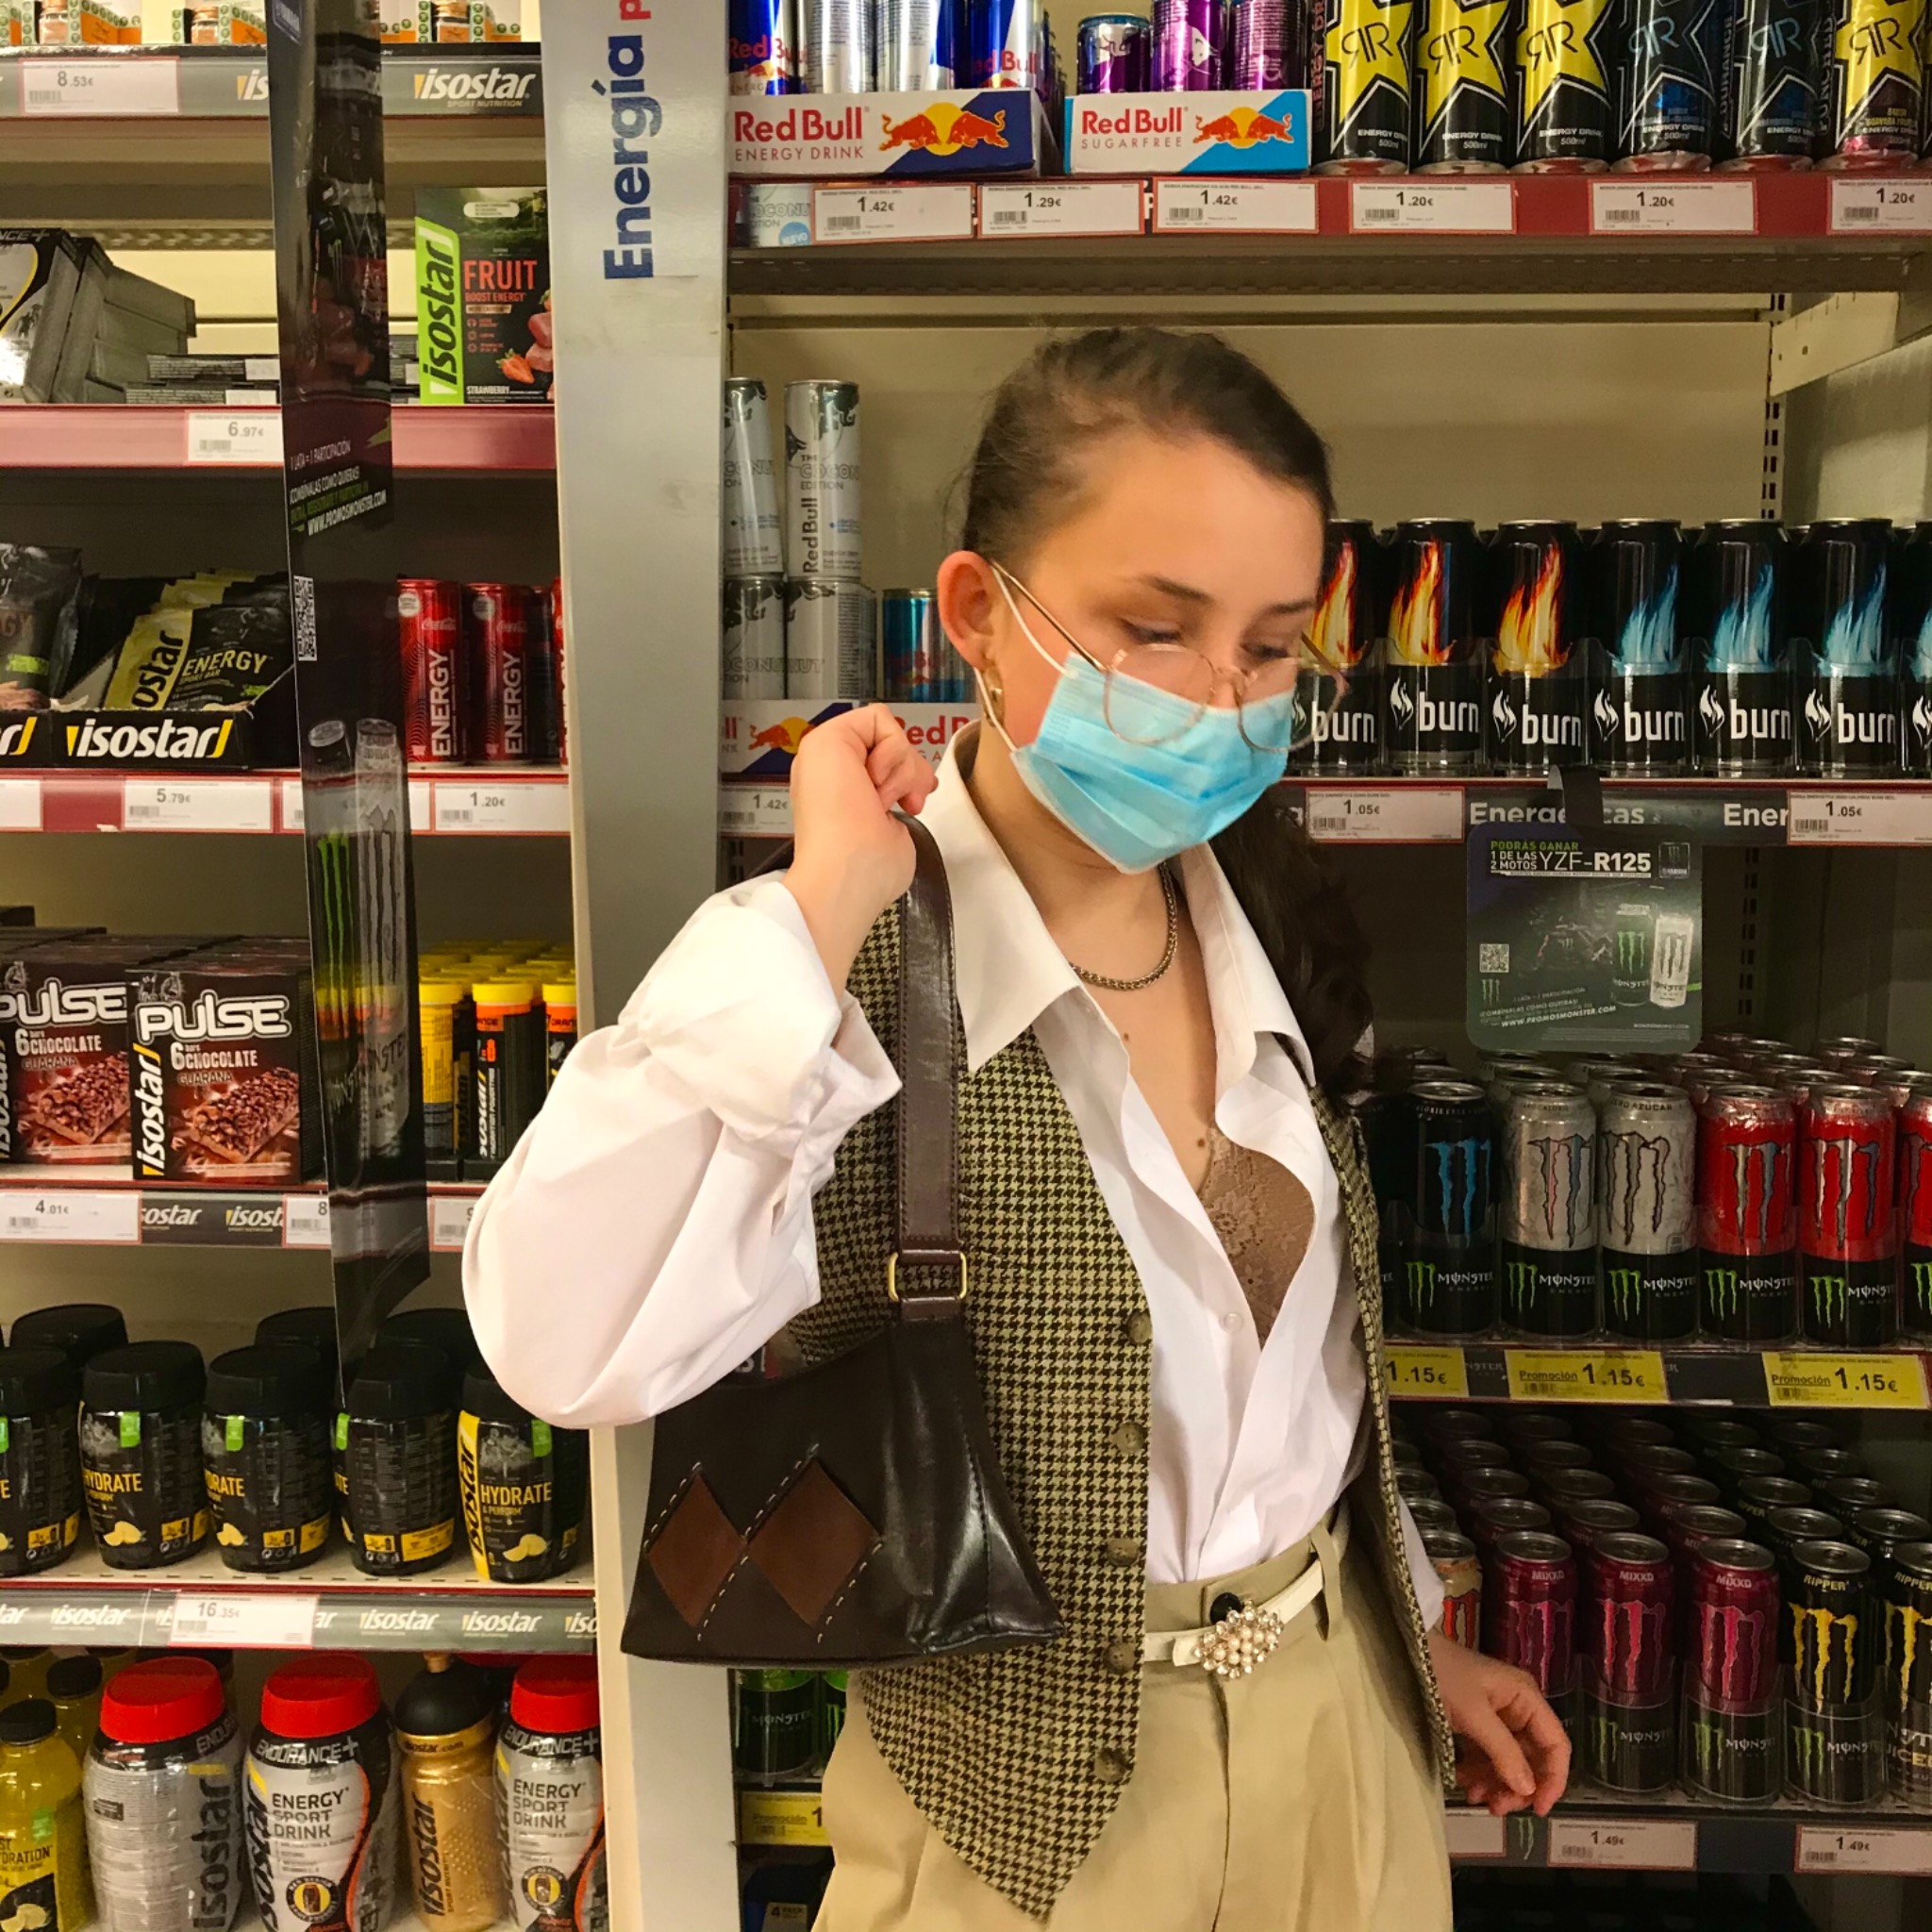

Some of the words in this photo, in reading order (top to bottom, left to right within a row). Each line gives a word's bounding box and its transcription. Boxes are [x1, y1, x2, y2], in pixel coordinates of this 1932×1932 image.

[57, 71, 94, 88] 8.53€
[420, 68, 537, 99] isostar
[447, 100, 475, 108] SPORT
[735, 108, 796, 142] Red
[803, 107, 862, 141] Bull
[1081, 108, 1130, 134] Red
[1135, 107, 1182, 133] Bull
[1642, 124, 1680, 133] ENERGY
[1357, 128, 1391, 139] ENERGY
[1442, 132, 1479, 141] ENERGY
[1539, 128, 1577, 138] ENERGY
[1766, 125, 1801, 135] ENERGY
[1081, 137, 1183, 149] SUGARFREE
[591, 35, 662, 279] Energía
[735, 147, 804, 161] ENERGY
[810, 146, 864, 160] DRINK
[857, 196, 895, 213] 1.42€
[1024, 192, 1061, 208] 1.29€
[1200, 190, 1239, 206] 1.42€
[1396, 191, 1434, 207] 1.20€
[1637, 191, 1674, 208] 1.20€
[1875, 188, 1916, 205] 1.20€
[463, 259, 538, 291] FRUIT
[465, 292, 492, 303] BOOST
[492, 291, 525, 302] ENERGY
[421, 240, 458, 385] isostar
[467, 385, 510, 395] STRAWBERRY
[228, 422, 264, 437] 6.97€
[801, 497, 819, 533] Bull
[802, 536, 819, 574] Red
[182, 649, 268, 675] ENERGY
[428, 649, 453, 757] ENERGY
[503, 651, 524, 755] ENERGY
[1419, 691, 1479, 734] burn
[1624, 700, 1686, 742] burn
[1730, 697, 1791, 740] burn
[1311, 700, 1377, 744] burn
[1521, 704, 1582, 746] burn
[1837, 702, 1896, 743] burn
[76, 718, 218, 758] isostar
[156, 788, 192, 803] 5.79€
[470, 791, 506, 807] 1.20€
[753, 794, 789, 810] 1.42€
[1342, 798, 1380, 815] 1.05€
[1824, 800, 1862, 818] 1.05€
[1491, 839, 1537, 851] PODRÁS
[1539, 841, 1579, 851] GANAR
[1491, 850, 1496, 860] 1
[1499, 850, 1514, 860] DE
[1516, 850, 1538, 860] LAS
[1539, 851, 1651, 872] YZF-R125
[1491, 860, 1497, 870] 2
[1499, 860, 1538, 870] MOTOS
[138, 991, 291, 1043] PULSE
[1501, 1005, 1616, 1027] WWW.PROMOSMONSTER.COM
[15, 1027, 29, 1057] 6
[29, 1034, 102, 1055] CHOCOLATE
[22, 1055, 79, 1072] GUARANA
[170, 1041, 184, 1071] 6
[184, 1049, 258, 1070] CHOCOLATE
[176, 1070, 235, 1086] GUARANA
[134, 1051, 165, 1169] isostar
[35, 1200, 69, 1215] 4.01€
[1386, 1360, 1447, 1385] 1.15€
[1519, 1370, 1578, 1382] Promoción
[1582, 1363, 1645, 1388] 1.15€
[1771, 1374, 1831, 1386] Promoción
[1835, 1367, 1898, 1392] 1.15€
[480, 1481, 553, 1506] HYDRATE
[1531, 1571, 1565, 1581] MIXXD
[1619, 1571, 1655, 1582] MIXXD
[1716, 1574, 1753, 1588] MIXXD
[1803, 1574, 1849, 1591] RIPPER
[55, 1604, 131, 1625] isostar
[363, 1609, 440, 1631] isostar
[466, 1610, 542, 1633] isostar
[504, 1724, 599, 1755] ENDURANCE+
[256, 1735, 359, 1767] ENDURANCE+
[513, 1778, 582, 1798] ENERGY
[272, 1788, 344, 1810] ENERGY
[513, 1795, 570, 1812] SPORT
[272, 1808, 333, 1824] SPORT
[513, 1811, 567, 1829] DRINK
[754, 1814, 808, 1825] Promoción
[274, 1824, 331, 1840] DRINK
[1591, 1829, 1625, 1846] 1.49€
[190, 1778, 231, 1928] isostar
[1836, 1836, 1871, 1852] 1.49€
[412, 1791, 445, 1916] isostar
